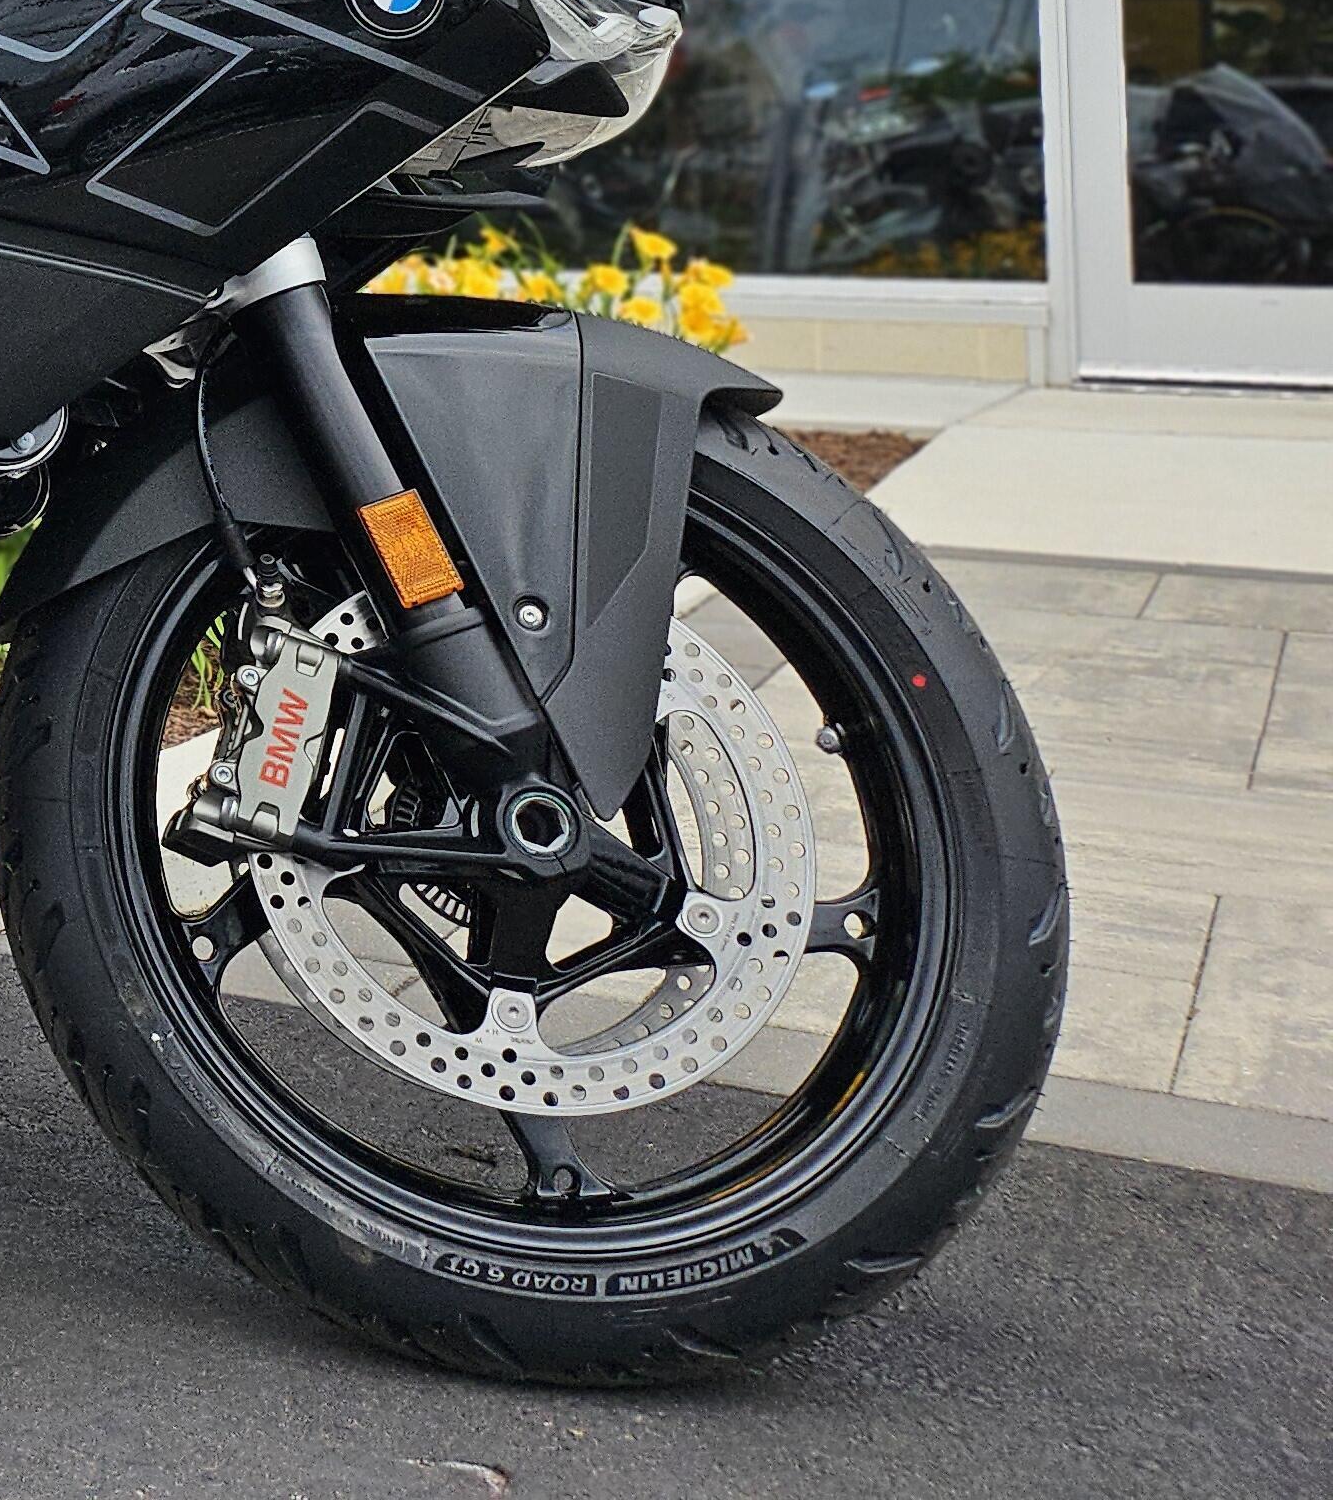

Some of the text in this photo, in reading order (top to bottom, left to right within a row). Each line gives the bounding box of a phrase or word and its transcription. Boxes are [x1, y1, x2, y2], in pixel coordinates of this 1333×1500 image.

[259, 687, 309, 788] BMW
[445, 1255, 588, 1293] ROAD 6 GT
[619, 1246, 754, 1293] MICHELIN
